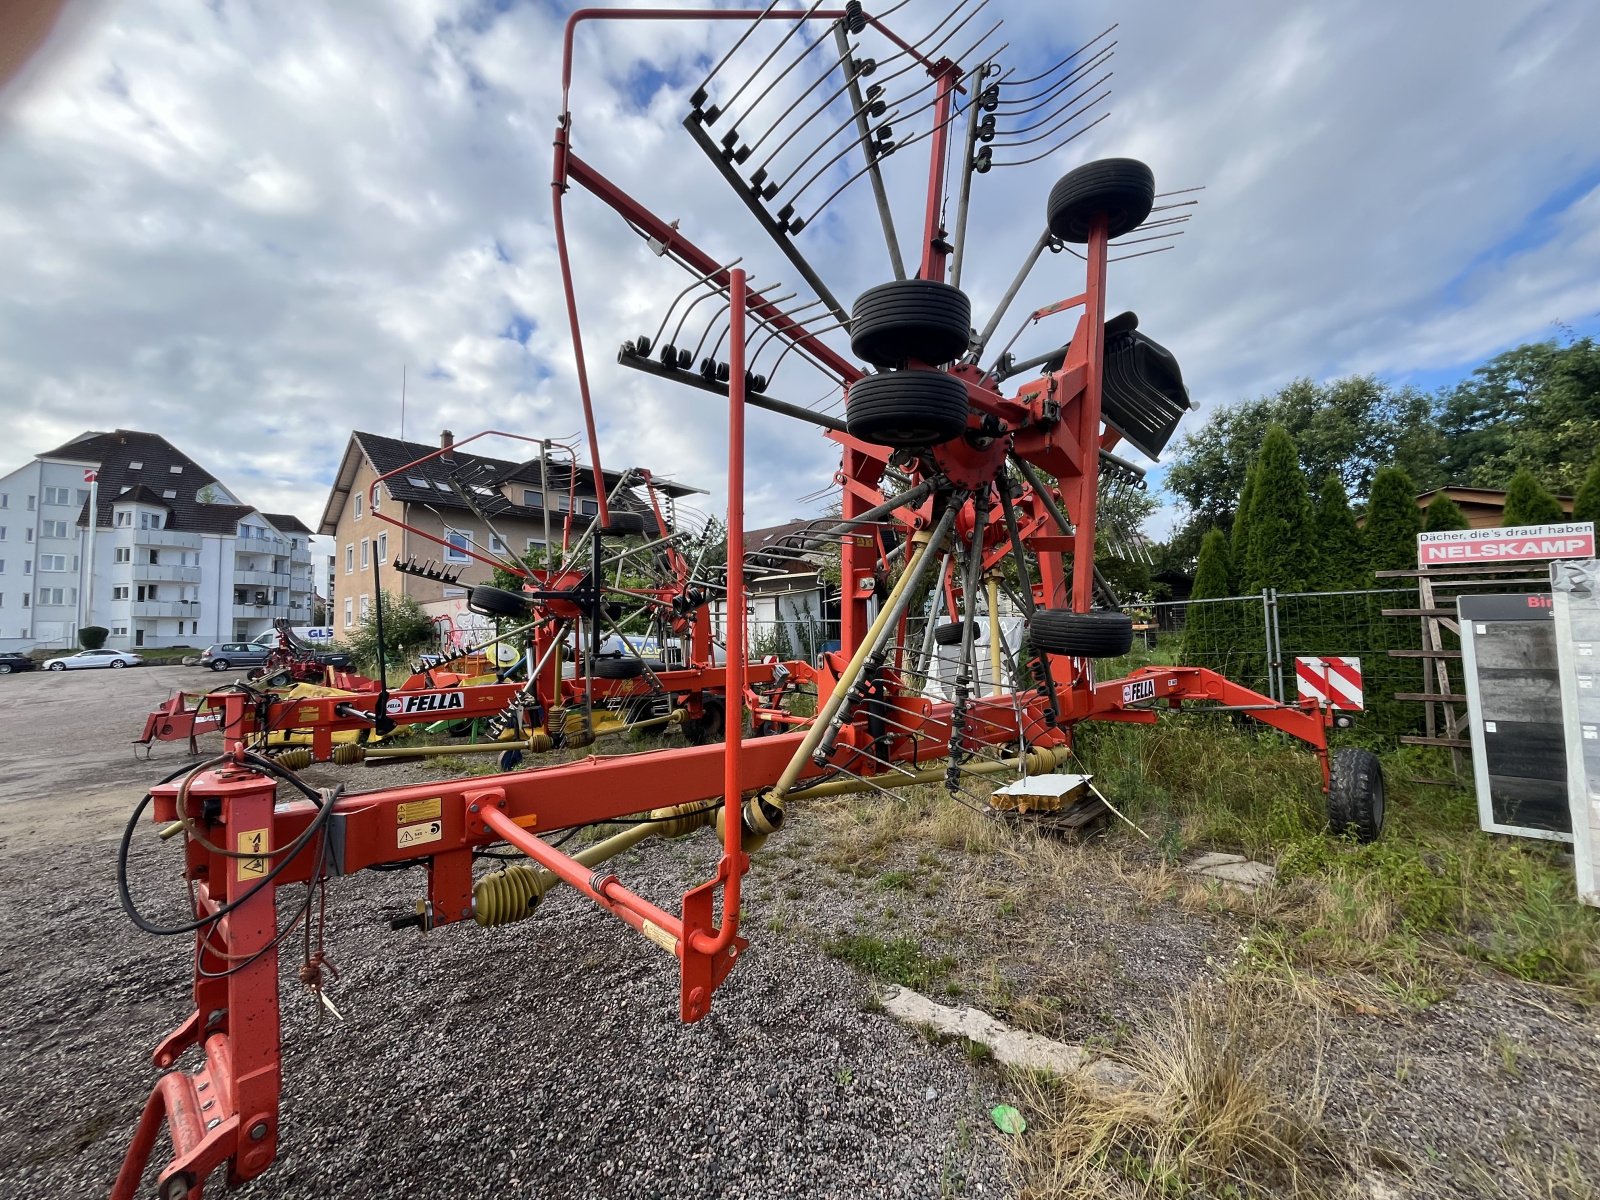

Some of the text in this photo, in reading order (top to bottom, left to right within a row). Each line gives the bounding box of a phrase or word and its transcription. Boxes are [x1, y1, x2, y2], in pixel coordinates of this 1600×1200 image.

[1470, 530, 1500, 539] die's
[1506, 527, 1543, 536] drauf
[1548, 525, 1592, 534] haben
[1429, 540, 1586, 559] NELSKAMP
[1132, 681, 1154, 700] FELLA
[405, 693, 462, 712] FELLA
